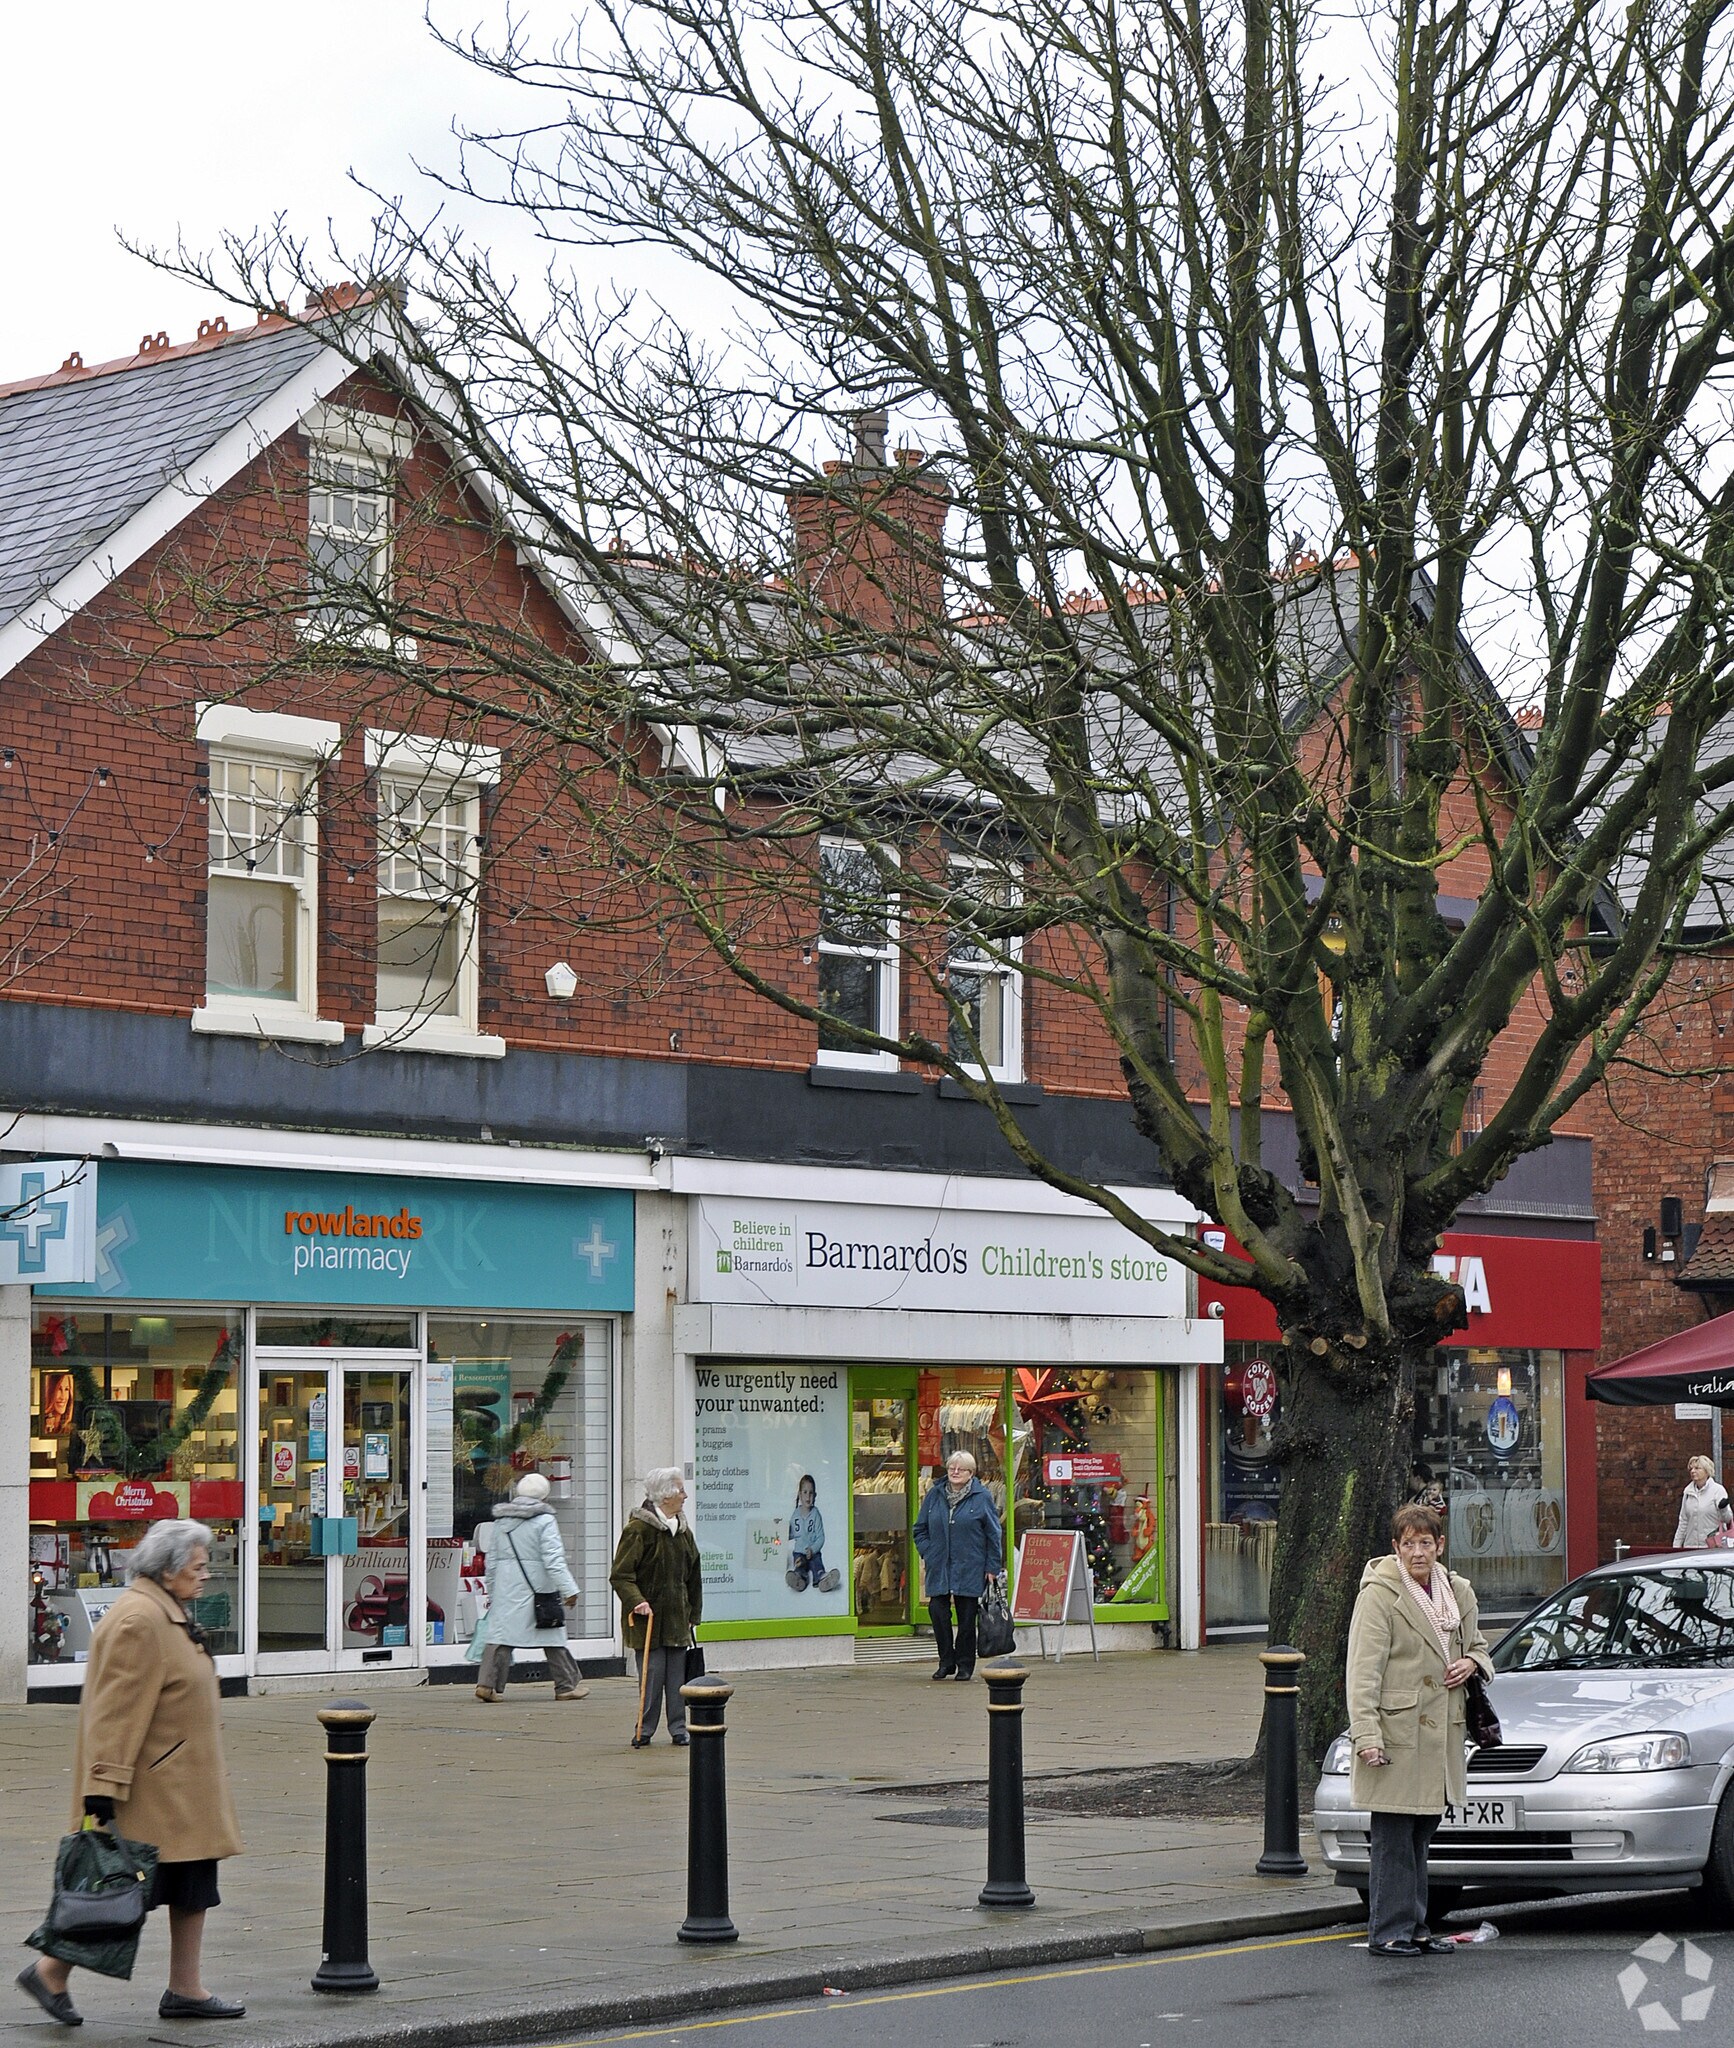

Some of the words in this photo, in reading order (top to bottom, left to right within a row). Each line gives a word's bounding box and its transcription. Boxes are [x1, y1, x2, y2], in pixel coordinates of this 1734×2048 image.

[284, 1204, 424, 1239] rowlands
[733, 1220, 777, 1235] Believe
[778, 1222, 792, 1236] in
[733, 1237, 784, 1252] children
[293, 1236, 412, 1279] pharmacy
[804, 1231, 968, 1274] Barnardo's
[733, 1255, 793, 1273] Barnardo's
[981, 1245, 1103, 1279] Children's
[1110, 1253, 1168, 1282] store
[1247, 1362, 1270, 1379] COSTA
[695, 1369, 720, 1388] We
[725, 1370, 796, 1393] urgently
[800, 1371, 838, 1389] need
[695, 1398, 735, 1417] your
[739, 1395, 825, 1413] unwanted:
[1246, 1394, 1273, 1414] COFFEE
[702, 1426, 727, 1436] prams
[702, 1440, 733, 1450] buggies
[702, 1454, 719, 1463] cots
[702, 1467, 720, 1478] baby
[722, 1467, 750, 1477] clothes
[1056, 1465, 1063, 1478] 8
[123, 1485, 147, 1498] Merry
[702, 1481, 734, 1492] bedding
[115, 1495, 154, 1507] Christmas
[696, 1501, 718, 1510] Please
[718, 1501, 742, 1509] donate
[743, 1501, 761, 1509] them
[696, 1513, 703, 1521] to
[704, 1513, 717, 1521] this
[719, 1513, 736, 1521] store
[1028, 1537, 1052, 1547] Gifts
[700, 1551, 725, 1560] elieve
[725, 1551, 734, 1560] in
[1026, 1547, 1036, 1556] in
[427, 1552, 453, 1574] ifts!
[1025, 1557, 1050, 1566] store
[1121, 1579, 1133, 1592] We
[1130, 1566, 1143, 1581] are
[1142, 1548, 1157, 1568] open
[701, 1573, 734, 1584] arnardo's
[1131, 1563, 1156, 1596] Sundays
[1463, 1802, 1504, 1824] FXR
